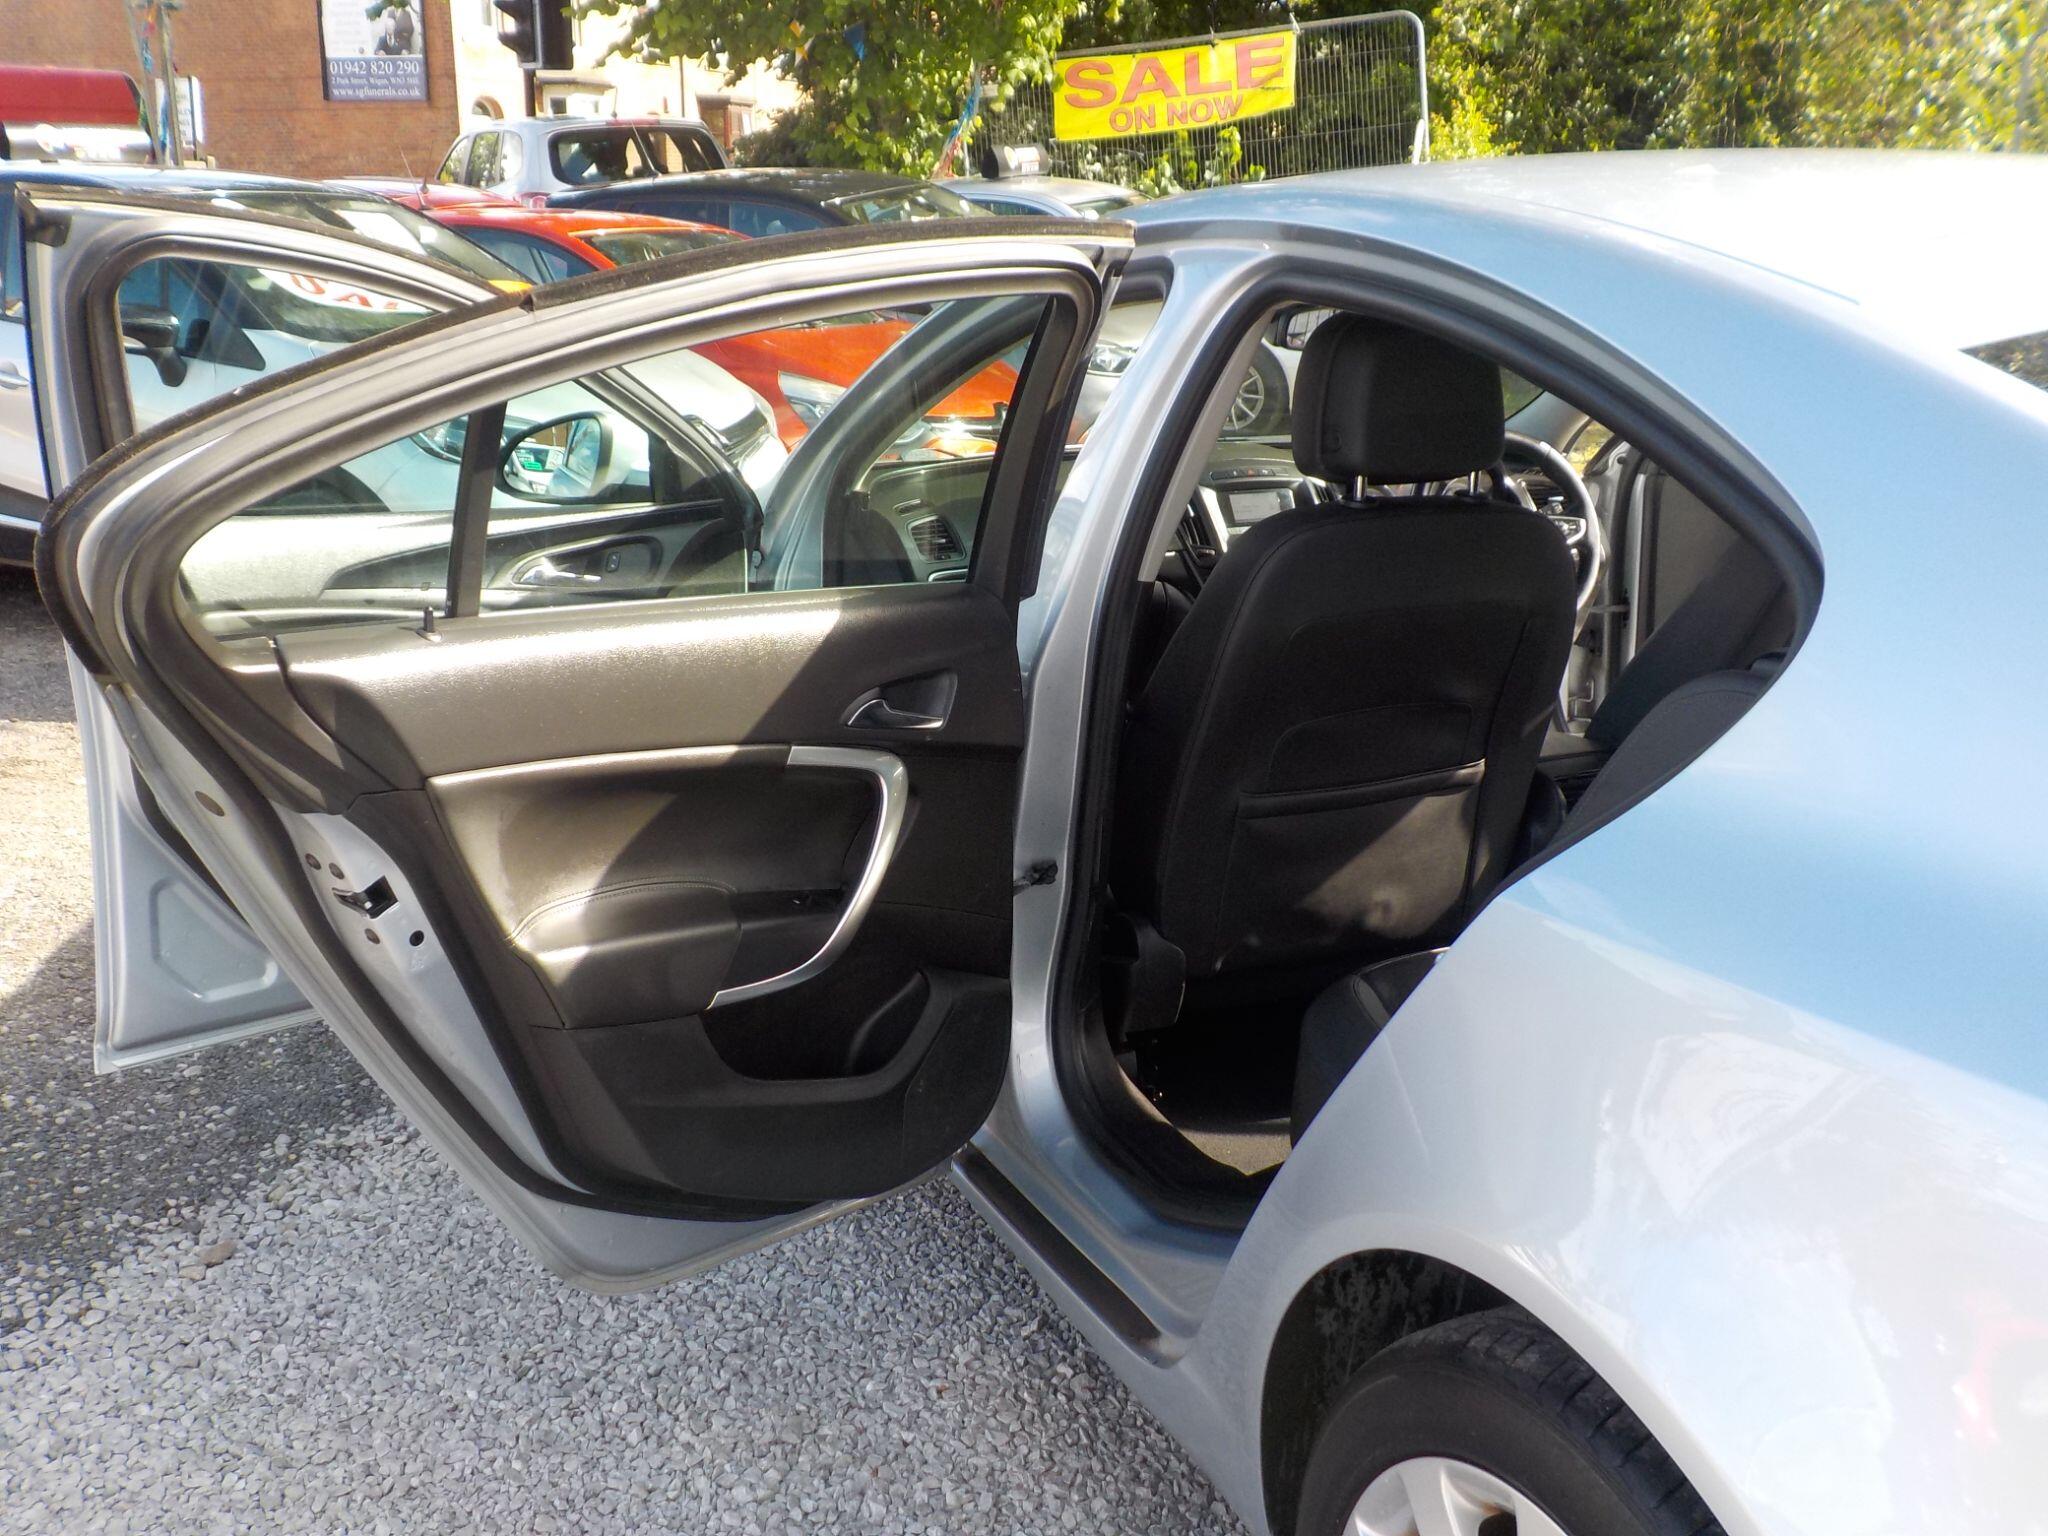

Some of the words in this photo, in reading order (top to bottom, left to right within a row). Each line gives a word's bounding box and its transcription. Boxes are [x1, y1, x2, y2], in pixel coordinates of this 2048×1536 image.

[330, 61, 366, 74] 01942
[370, 61, 393, 74] 820
[397, 61, 419, 74] 290
[1065, 37, 1284, 108] SALE
[333, 86, 420, 98] www.sgfunerals.co.uk
[1109, 103, 1156, 132] ON
[1167, 94, 1243, 127] NOW
